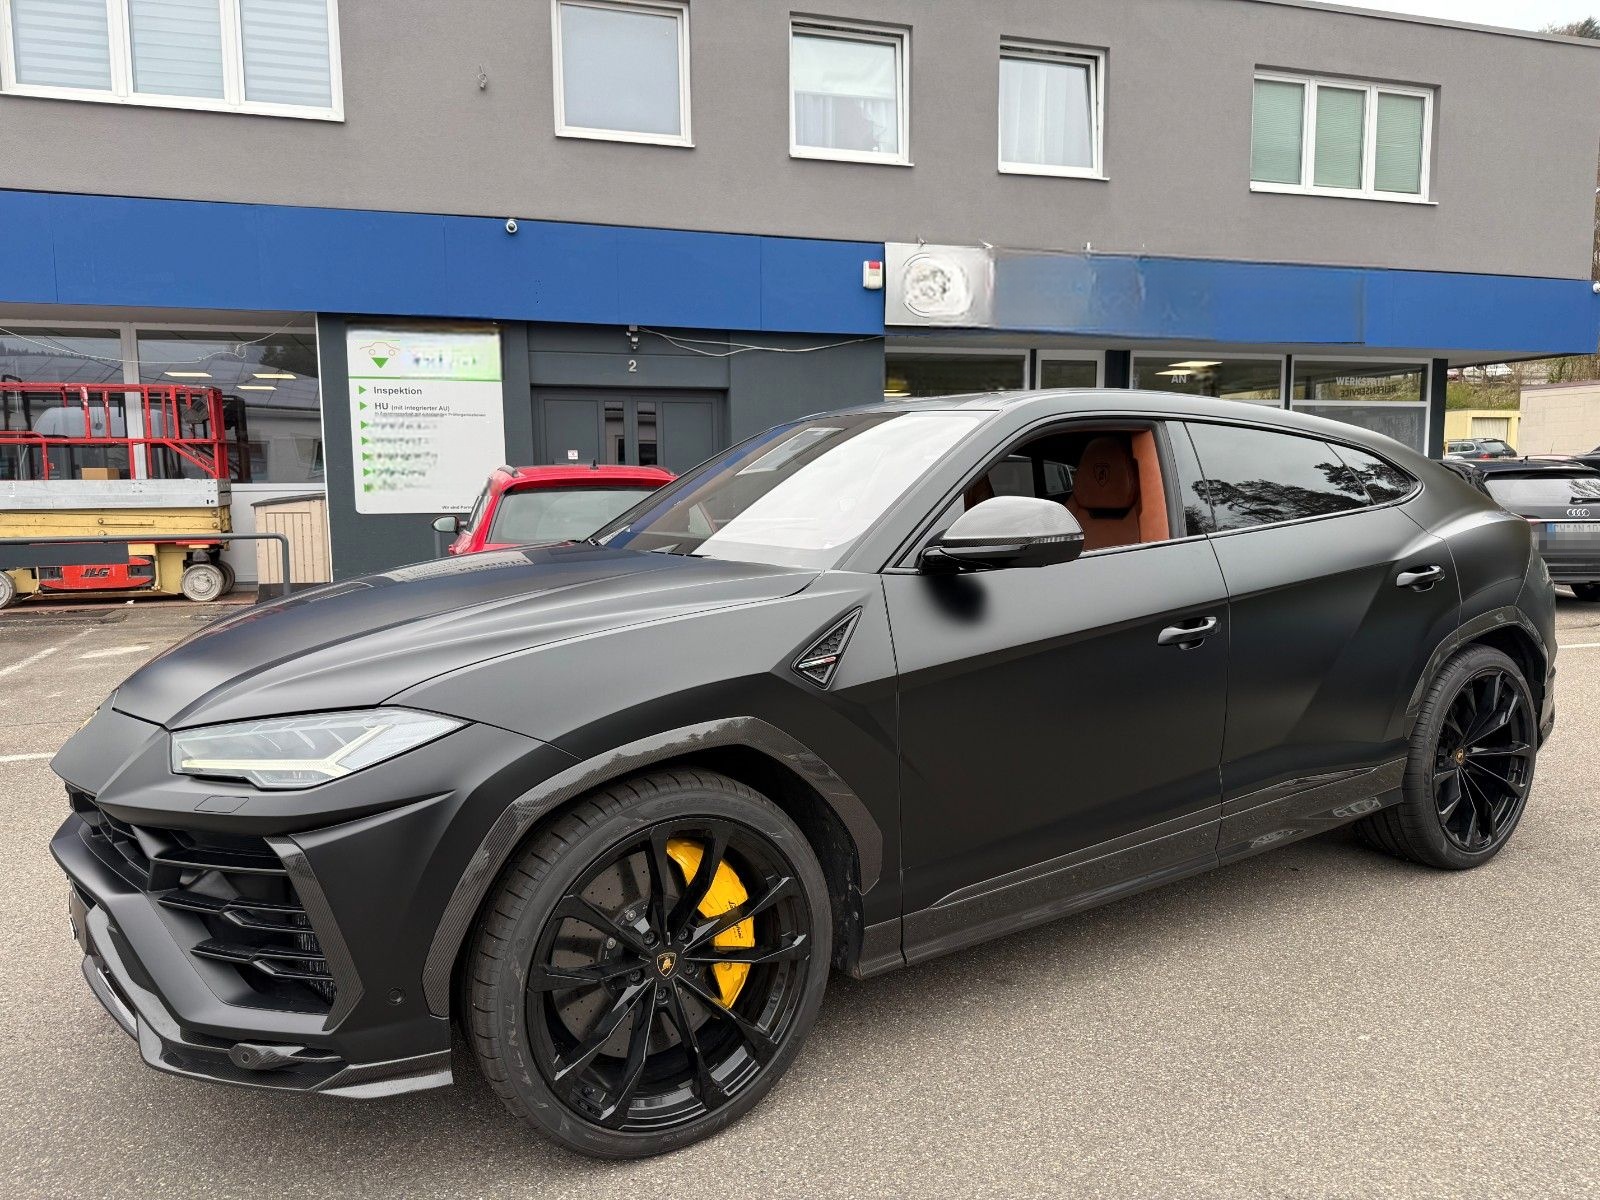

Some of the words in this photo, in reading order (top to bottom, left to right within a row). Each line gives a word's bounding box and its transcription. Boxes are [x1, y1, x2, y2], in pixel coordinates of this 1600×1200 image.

[628, 359, 637, 371] 2
[1335, 376, 1387, 386] WERKSTATT
[373, 386, 423, 396] Inspektion
[374, 402, 389, 410] HU
[80, 567, 111, 578] JLG
